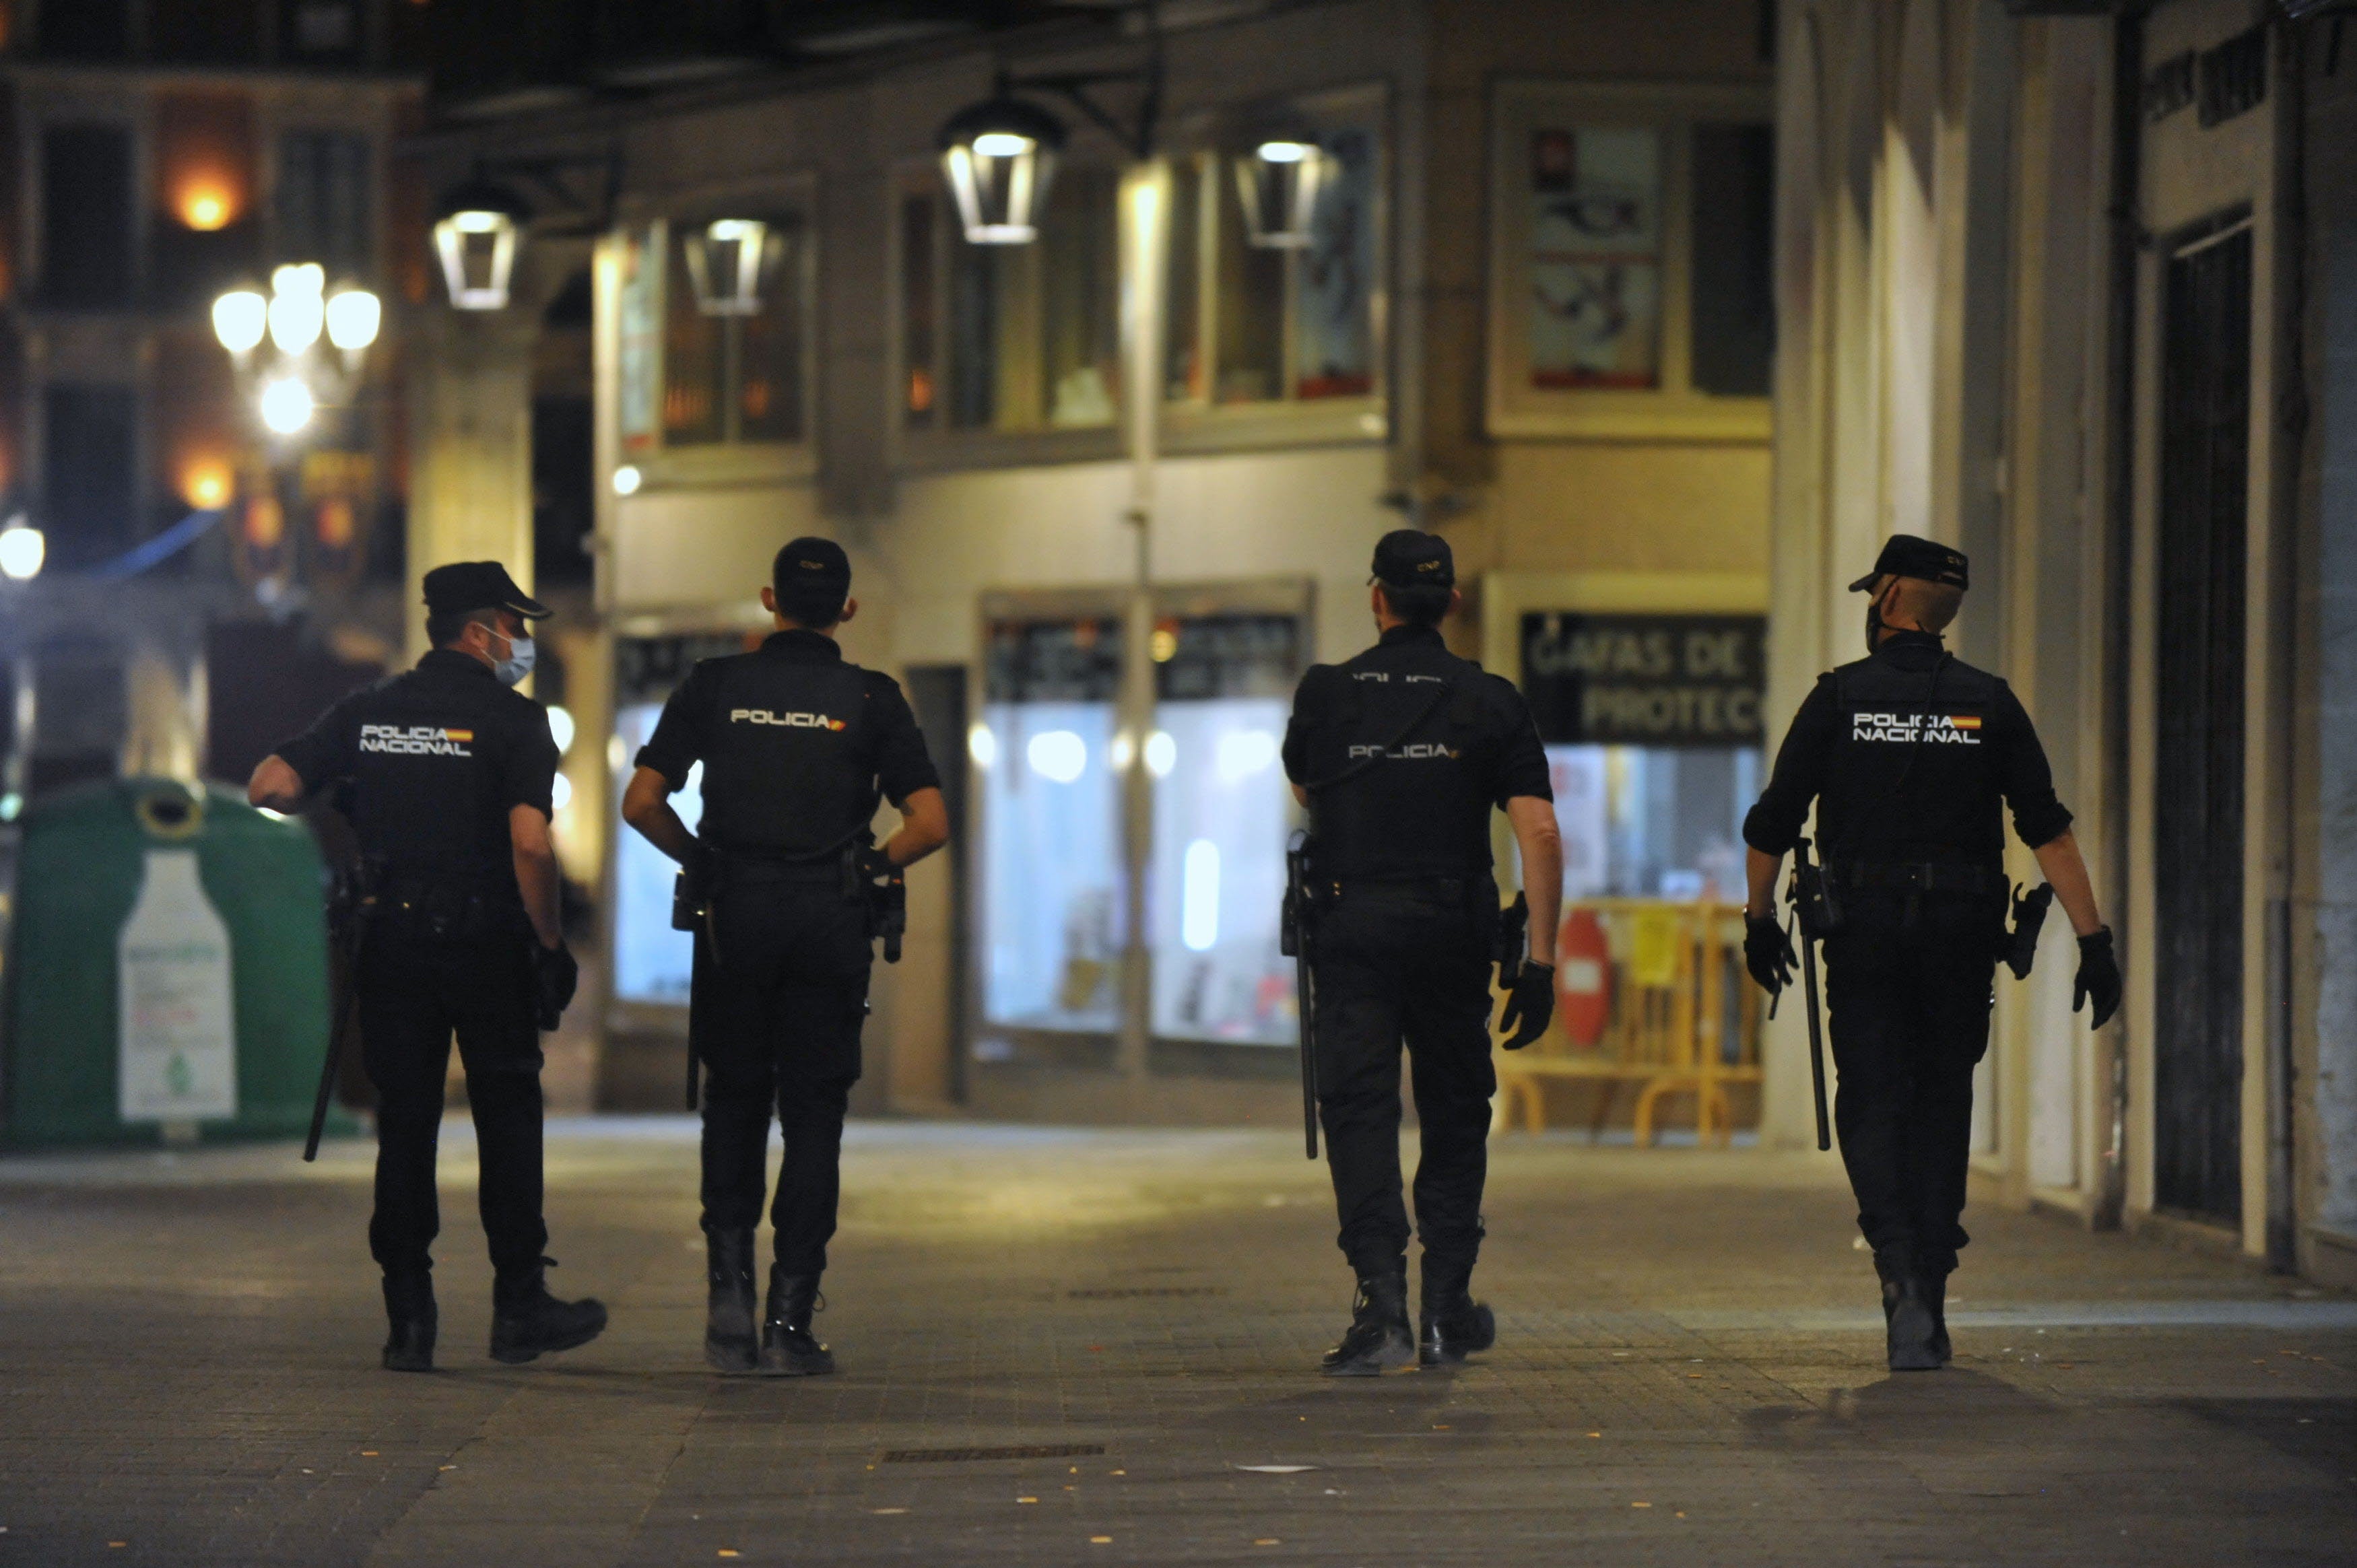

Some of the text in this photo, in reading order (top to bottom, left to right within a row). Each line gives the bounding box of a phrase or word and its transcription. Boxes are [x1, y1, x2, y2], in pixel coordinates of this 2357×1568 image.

[1685, 630, 1744, 676] DE
[731, 709, 830, 728] POLICIA
[361, 724, 448, 741] POLICIA
[360, 739, 471, 757] NACIONAL
